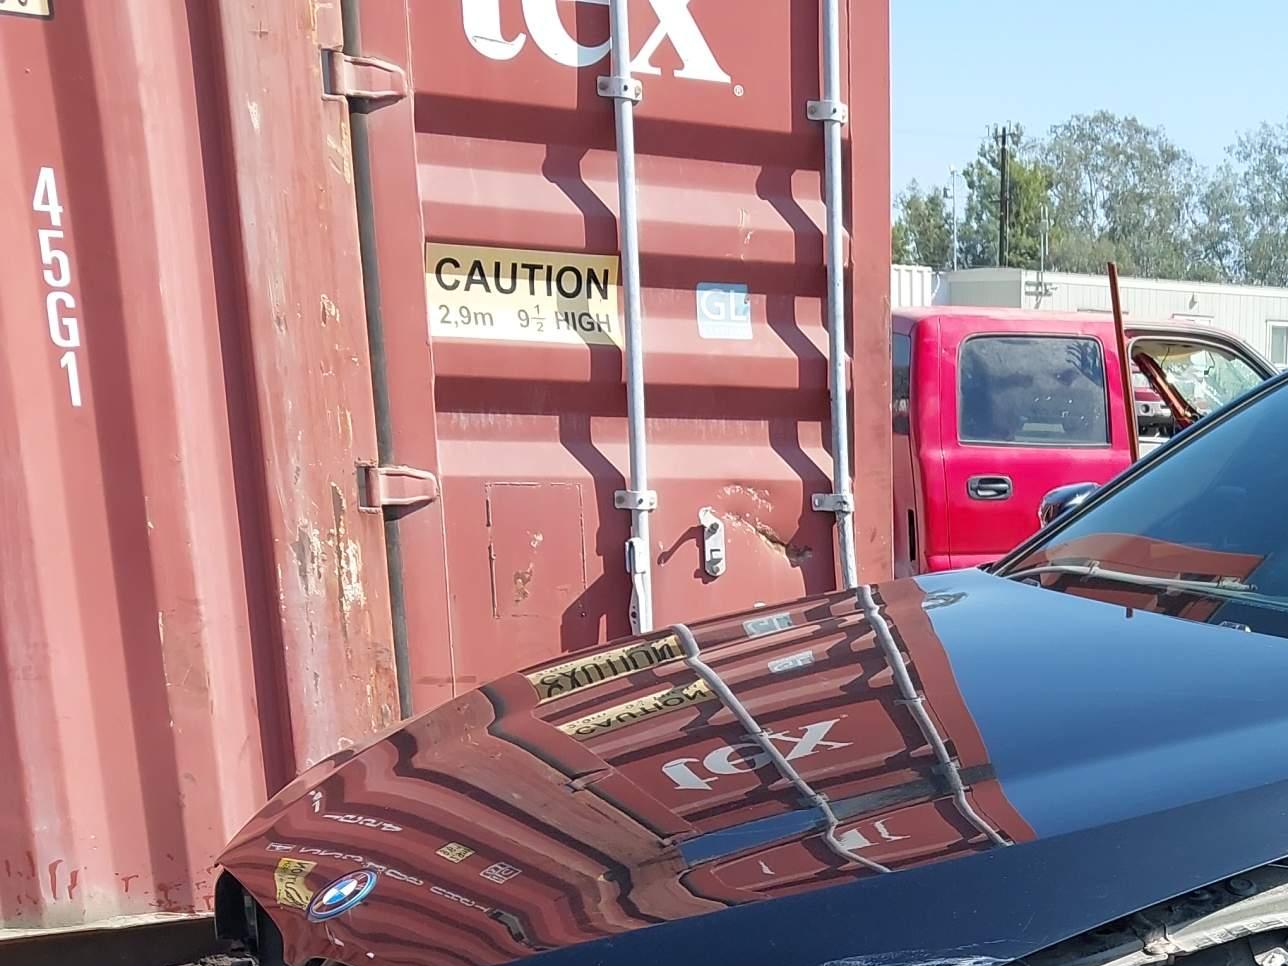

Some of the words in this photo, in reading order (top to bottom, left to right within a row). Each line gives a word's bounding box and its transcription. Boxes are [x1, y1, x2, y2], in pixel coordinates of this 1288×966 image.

[32, 166, 82, 407] 45G1
[435, 257, 609, 300] CAUTION
[438, 304, 494, 328] 2,9m
[556, 311, 611, 333] HIGH
